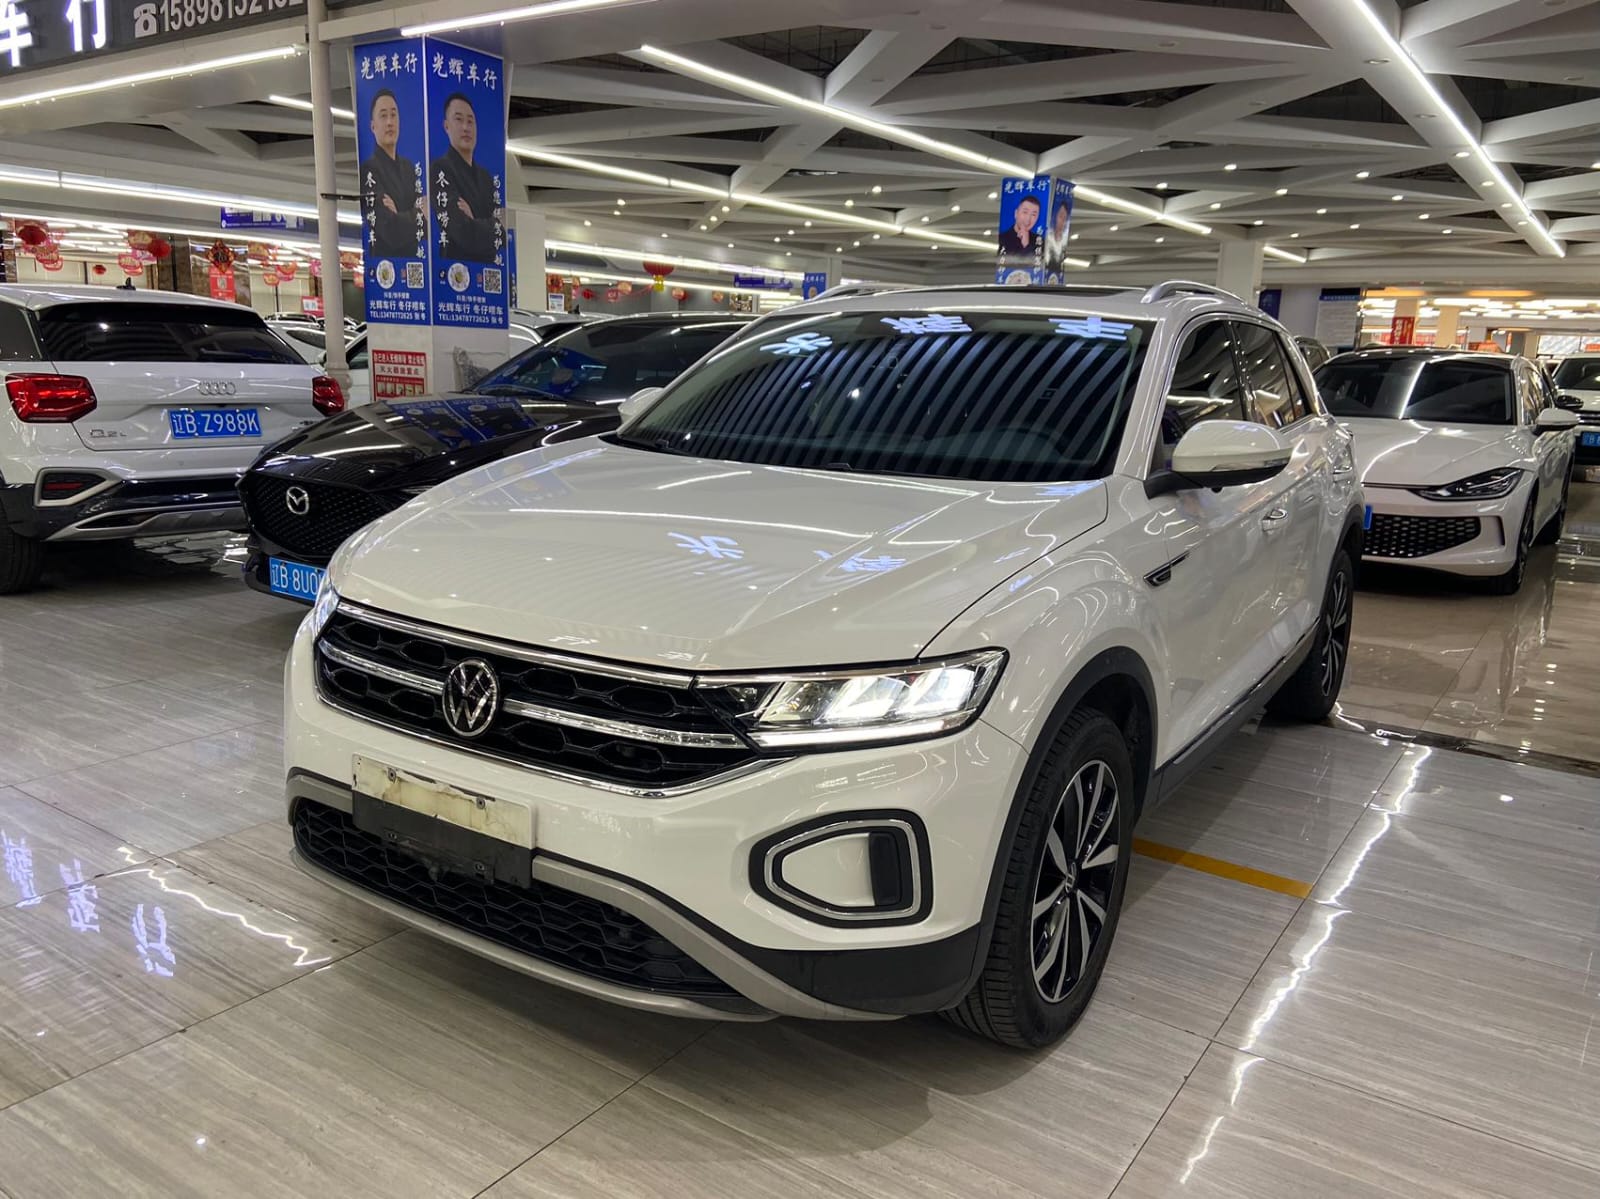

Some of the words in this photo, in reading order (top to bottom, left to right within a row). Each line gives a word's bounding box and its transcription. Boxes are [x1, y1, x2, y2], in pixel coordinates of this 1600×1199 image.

[361, 52, 418, 79] 光辉车行
[433, 52, 497, 90] 光辉车行
[271, 564, 323, 595] 辽B·8U0
